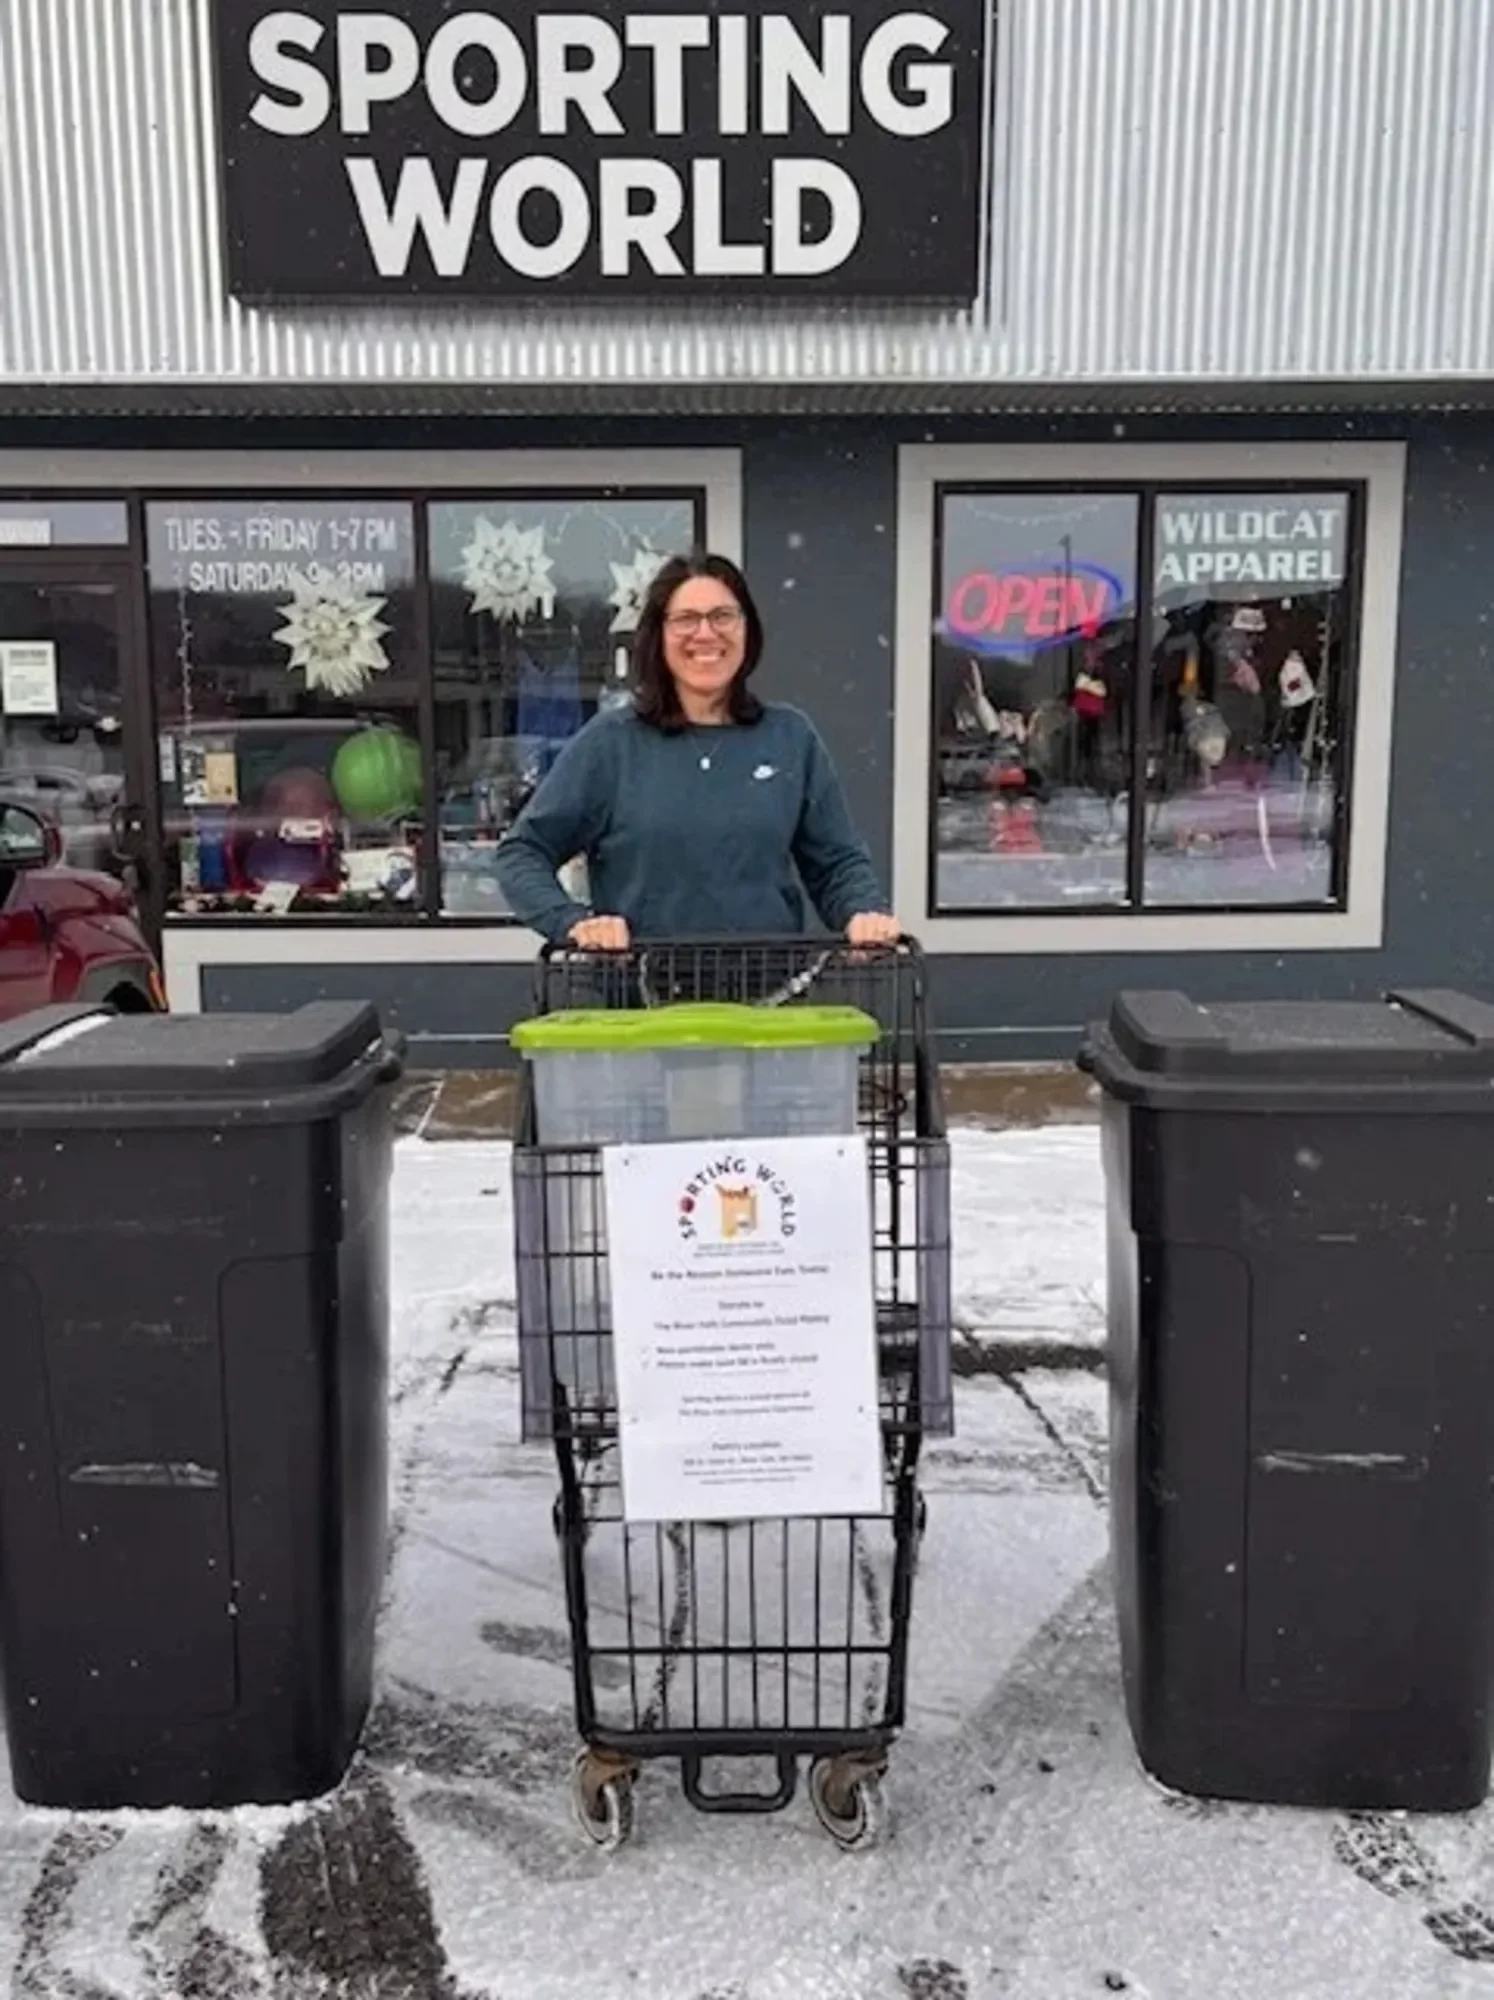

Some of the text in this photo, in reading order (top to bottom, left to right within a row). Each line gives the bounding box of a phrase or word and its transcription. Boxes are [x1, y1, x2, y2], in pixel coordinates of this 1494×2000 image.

[248, 11, 955, 136] SPORTING
[344, 155, 862, 277] WORLD
[245, 517, 322, 552] FRIDAY
[1161, 508, 1343, 545] WILDCAT
[188, 561, 297, 592] SATURDAY
[1157, 550, 1342, 583] APPAREL
[946, 571, 1108, 637] OPEN
